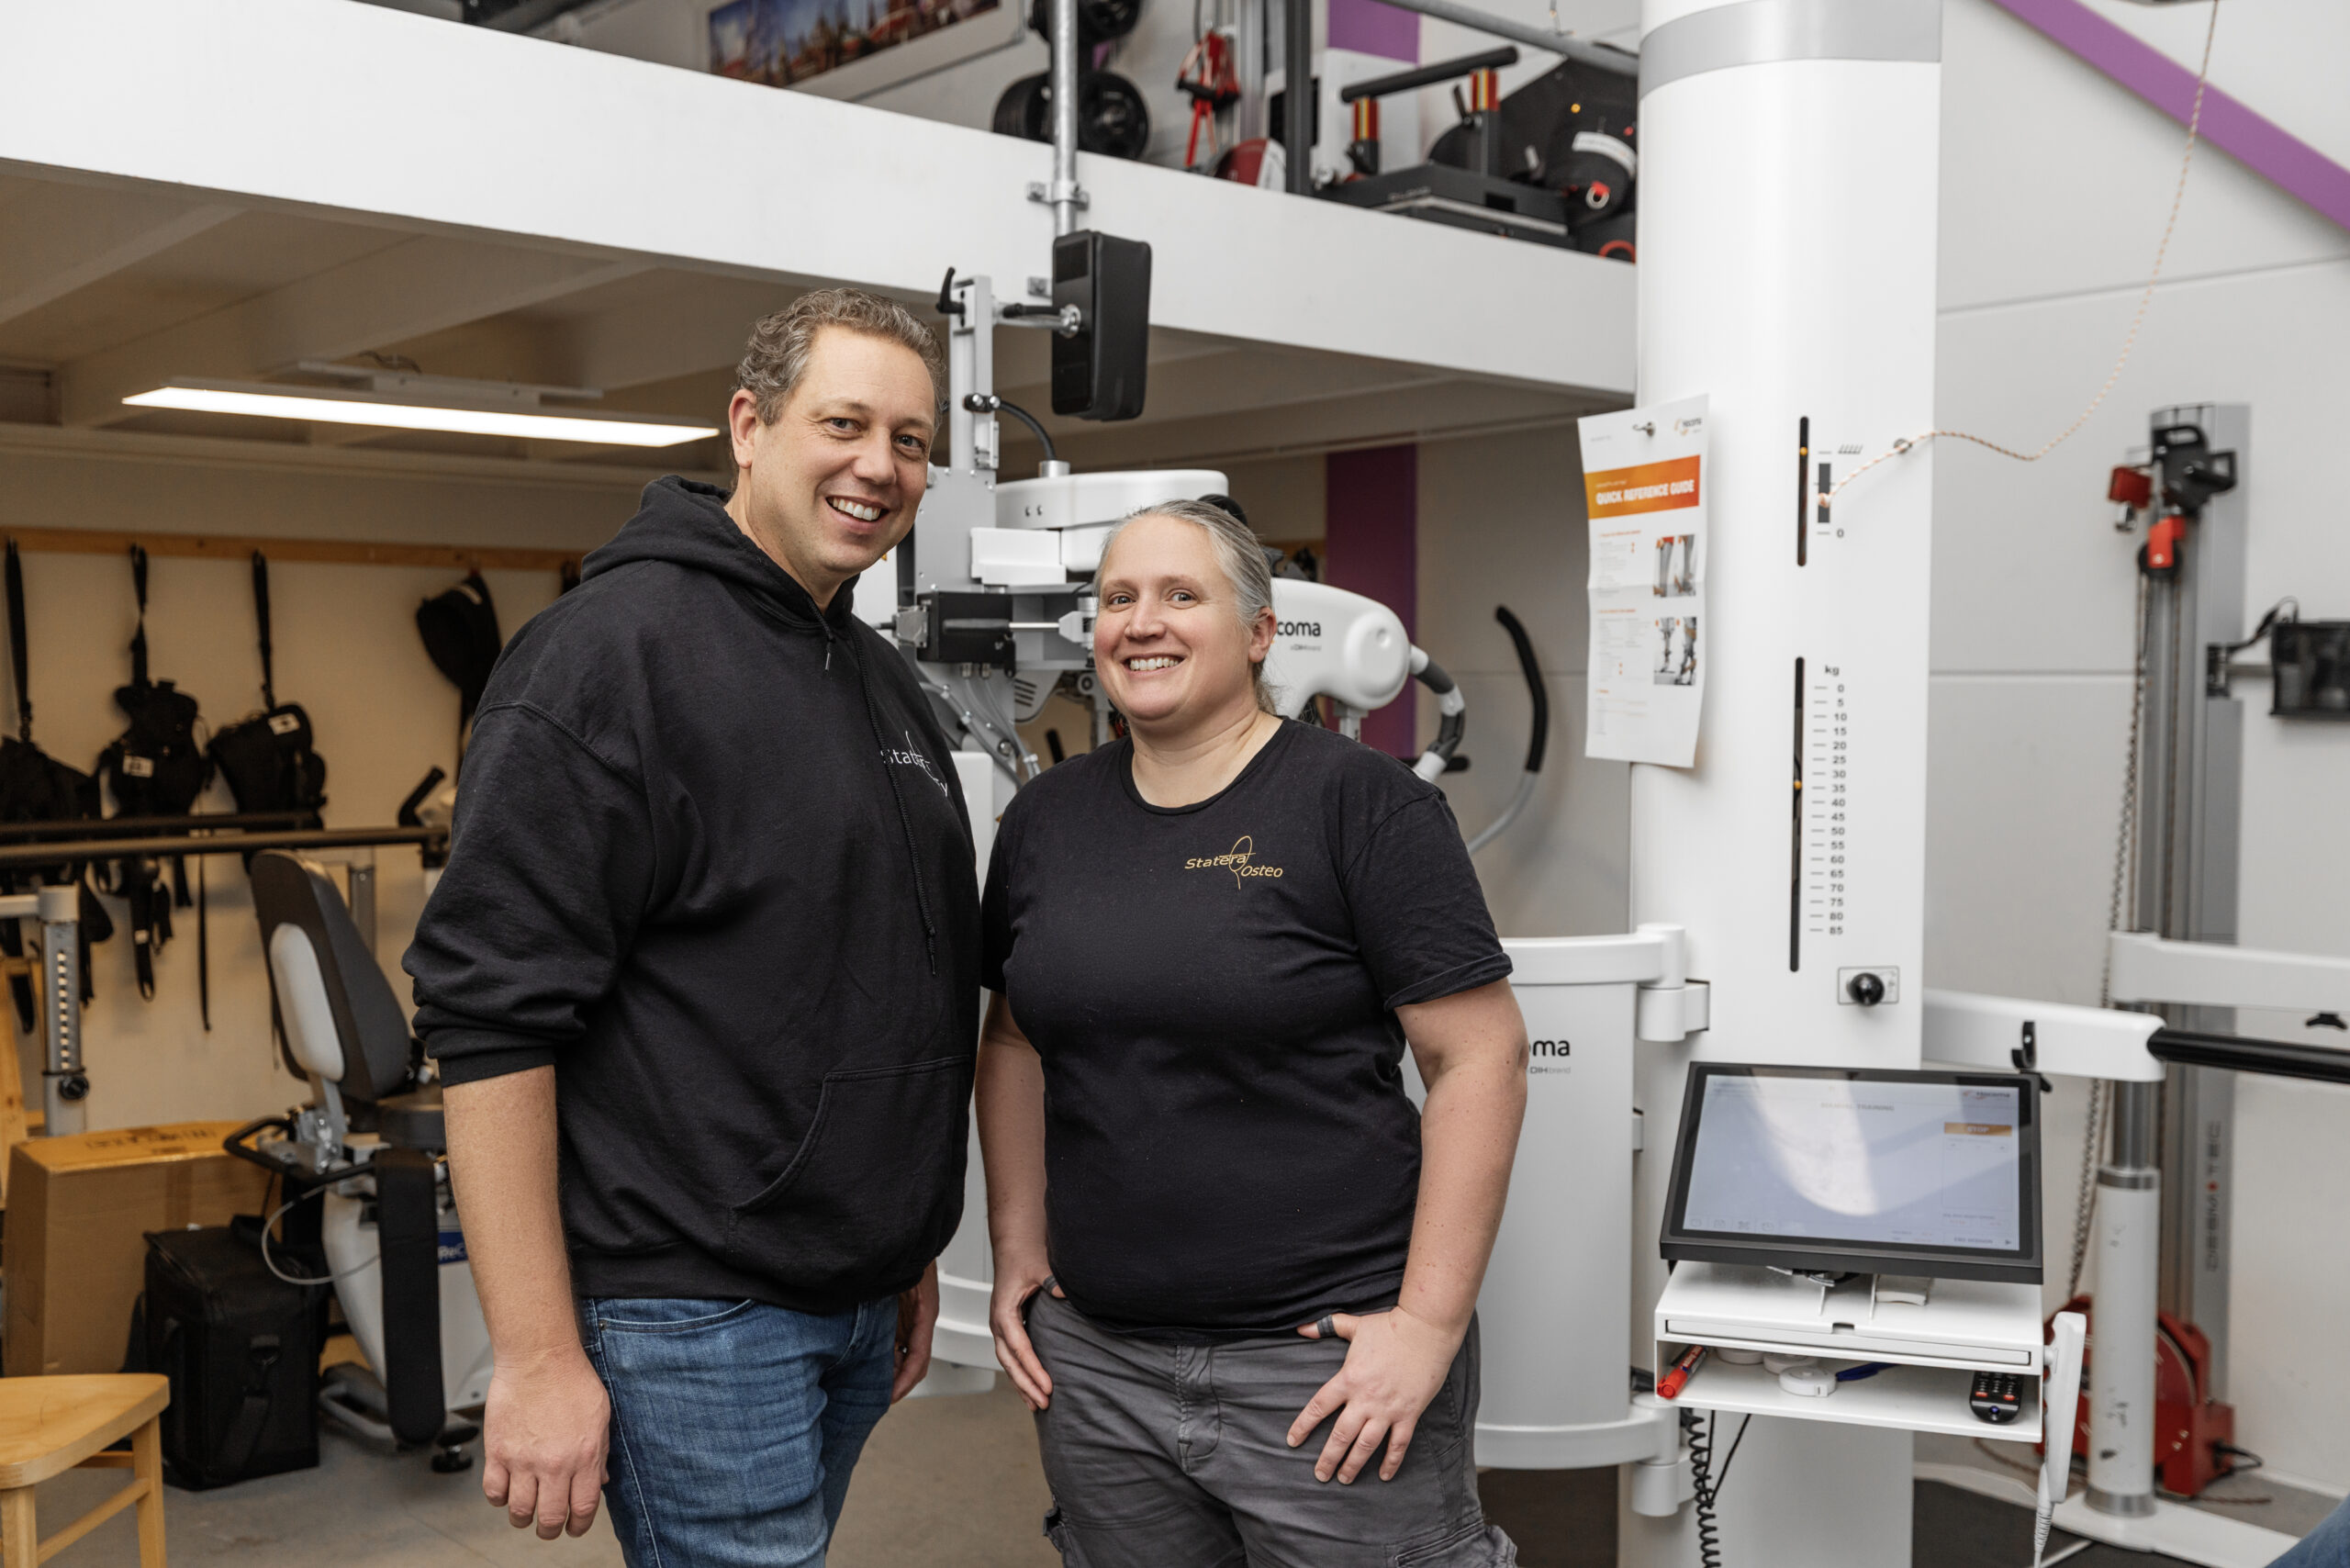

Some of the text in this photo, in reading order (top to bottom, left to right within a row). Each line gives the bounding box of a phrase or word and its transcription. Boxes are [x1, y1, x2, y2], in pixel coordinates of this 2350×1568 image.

[1595, 490, 1624, 506] QUICK
[1623, 483, 1669, 502] REFERENCE
[1670, 479, 1695, 496] GUIDE
[1277, 622, 1321, 636] coma
[1824, 664, 1841, 678] kg
[1833, 712, 1848, 722] 10
[1833, 726, 1848, 736] 15
[1832, 740, 1848, 751] 20
[1832, 755, 1847, 765] 25
[1832, 769, 1847, 779] 30
[1831, 783, 1846, 794] 35
[1830, 798, 1846, 808] 40
[1830, 812, 1846, 823] 45
[1830, 826, 1846, 836] 50
[1830, 840, 1845, 850] 55
[1184, 854, 1247, 869] Statera
[1830, 855, 1845, 865] 60
[1240, 864, 1283, 879] Osteo
[1830, 868, 1845, 879] 65
[1830, 882, 1845, 893] 70
[1830, 897, 1844, 907] 75
[1829, 911, 1844, 922] 80
[1829, 924, 1844, 935] 85
[1528, 1039, 1571, 1057] ma
[1966, 1126, 1990, 1135] STOP
